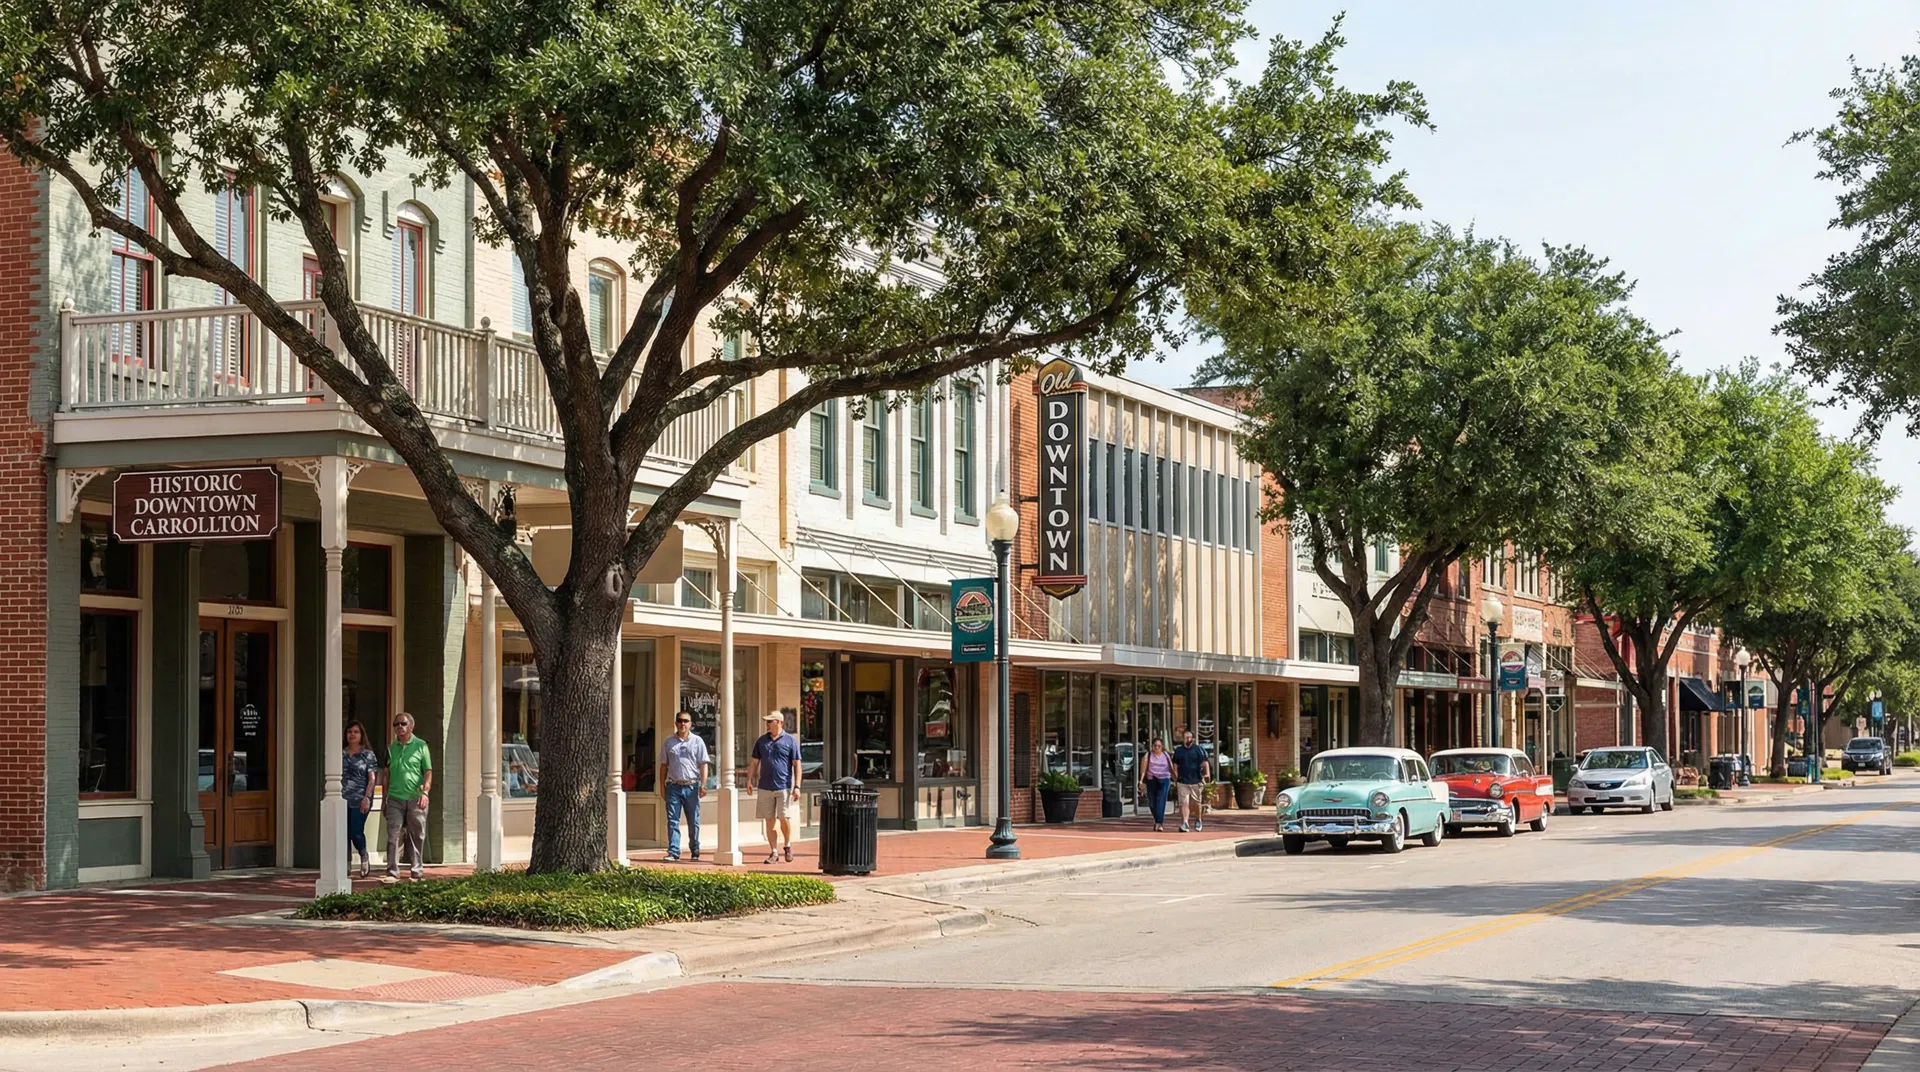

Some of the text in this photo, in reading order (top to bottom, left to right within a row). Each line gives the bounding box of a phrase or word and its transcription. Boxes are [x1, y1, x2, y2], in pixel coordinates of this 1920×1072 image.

[1041, 368, 1075, 394] Old
[149, 474, 242, 493] HISTORIC
[1045, 401, 1071, 571] DOWNTOWN
[134, 495, 257, 514] DOWNTOWN
[130, 514, 260, 535] CARROLLTON
